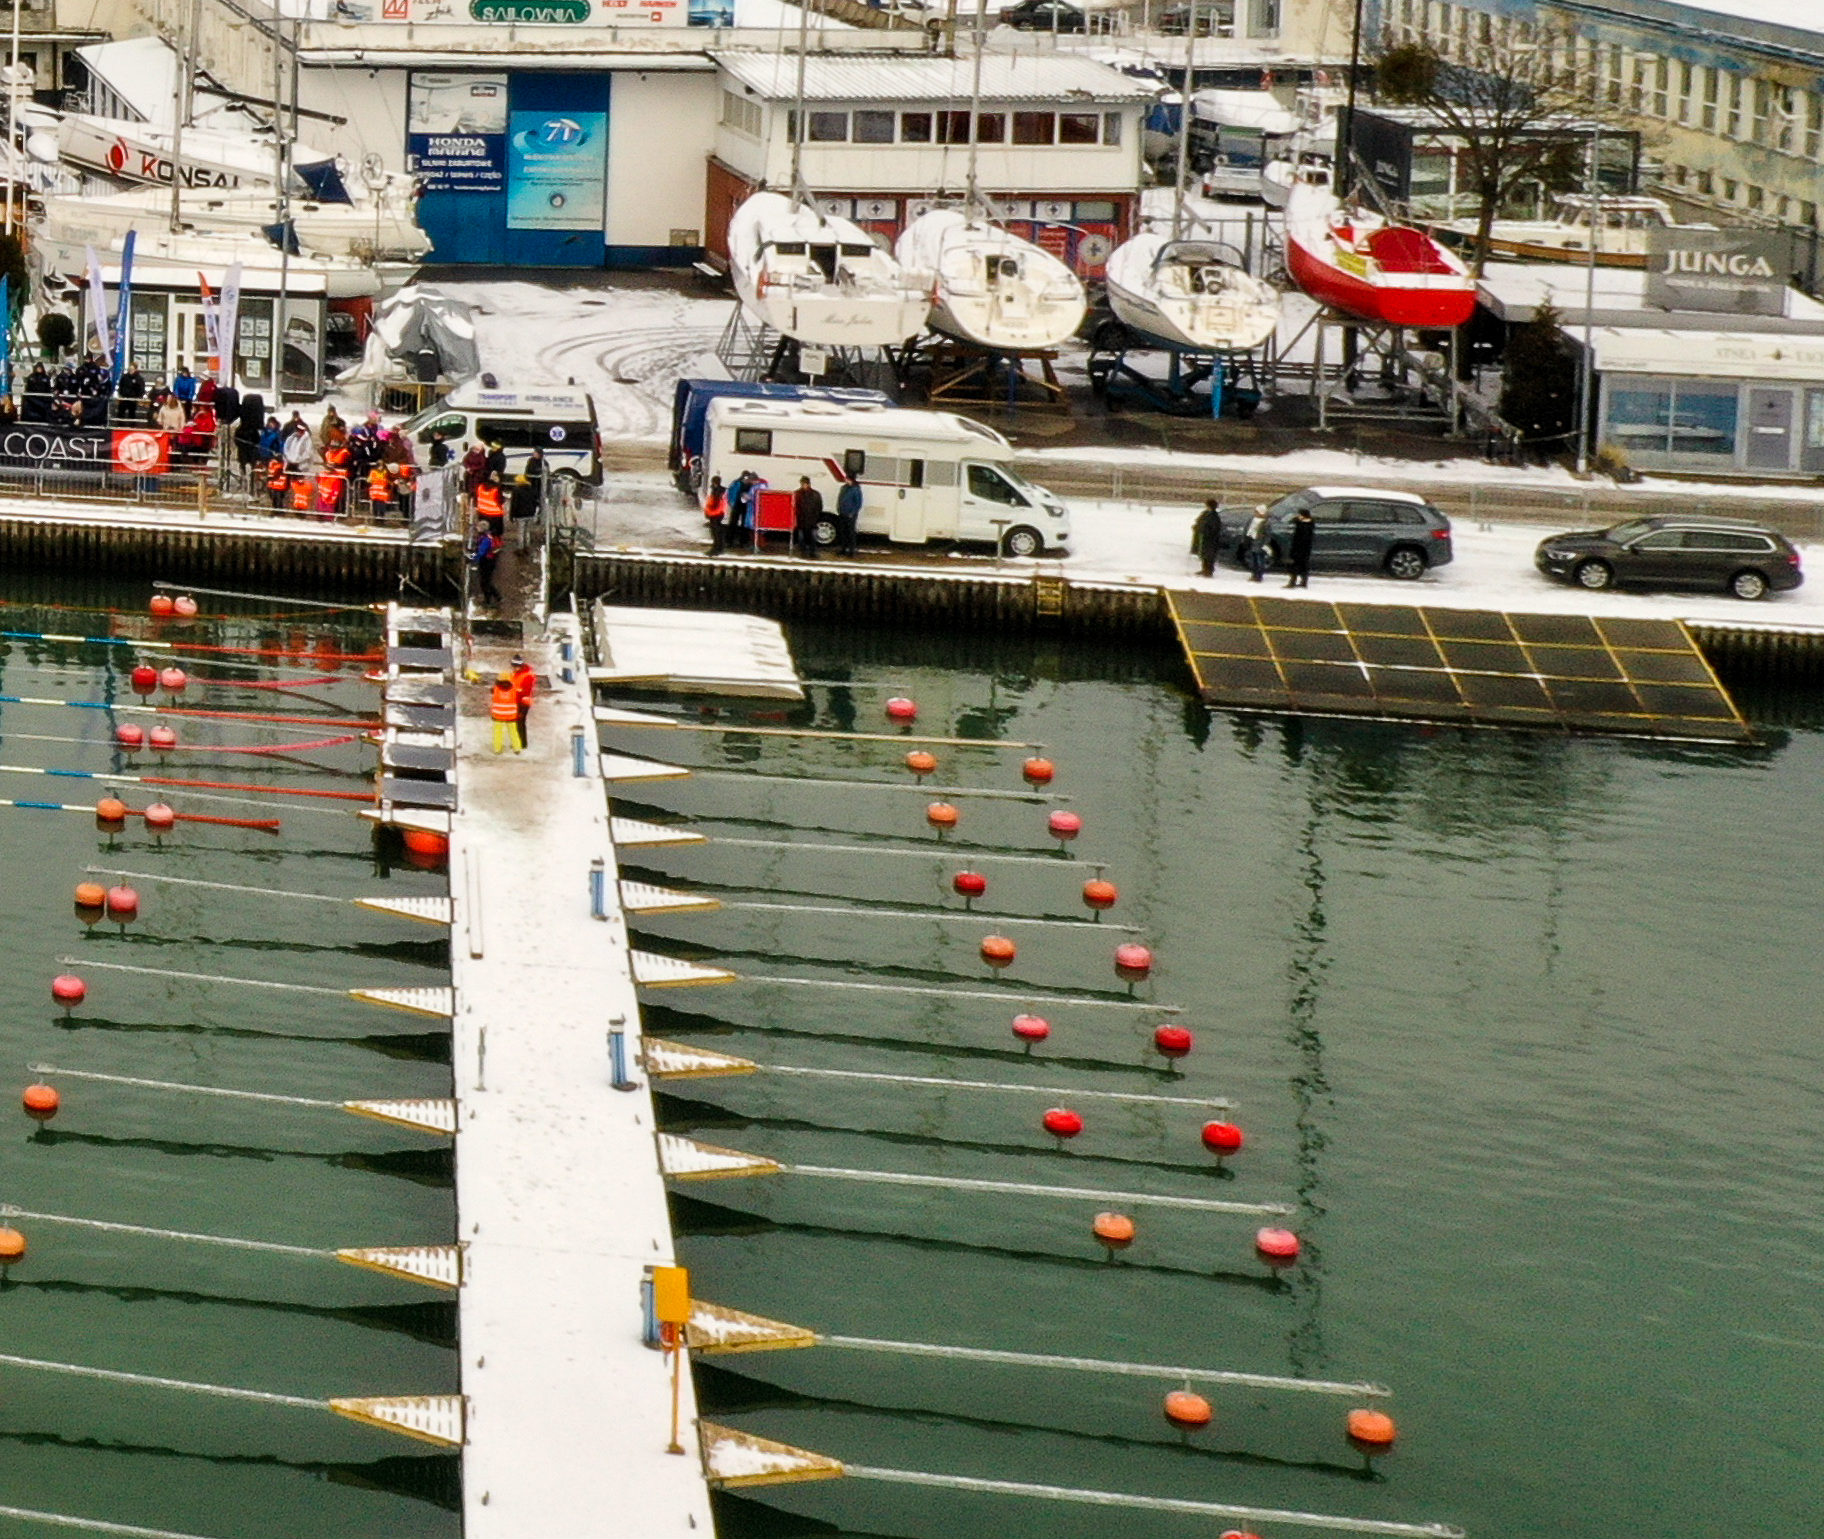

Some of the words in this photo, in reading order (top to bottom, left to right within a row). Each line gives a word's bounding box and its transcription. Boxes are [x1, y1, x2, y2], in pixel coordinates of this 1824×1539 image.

[427, 138, 487, 147] HONDA
[1663, 250, 1774, 277] JUNGA
[4, 432, 105, 460] COAST
